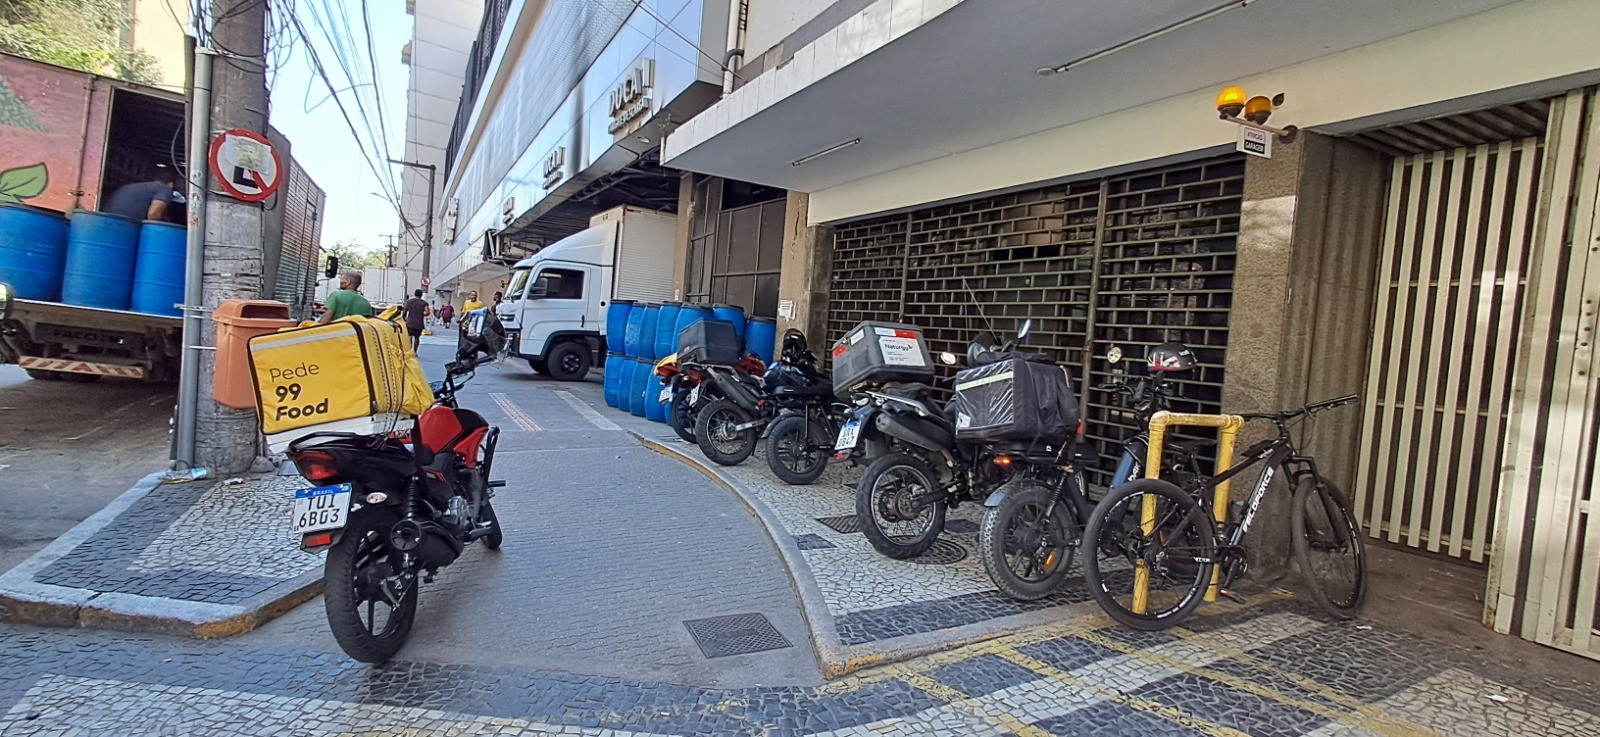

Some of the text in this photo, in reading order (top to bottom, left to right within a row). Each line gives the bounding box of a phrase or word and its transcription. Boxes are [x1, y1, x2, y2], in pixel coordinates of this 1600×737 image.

[884, 343, 909, 352] Naturgy
[269, 362, 320, 382] Pede
[275, 383, 302, 403] 99
[275, 398, 329, 422] Food
[308, 494, 336, 511] TUI
[1242, 466, 1275, 533] VELOFORCE
[299, 508, 340, 528] 6B03
